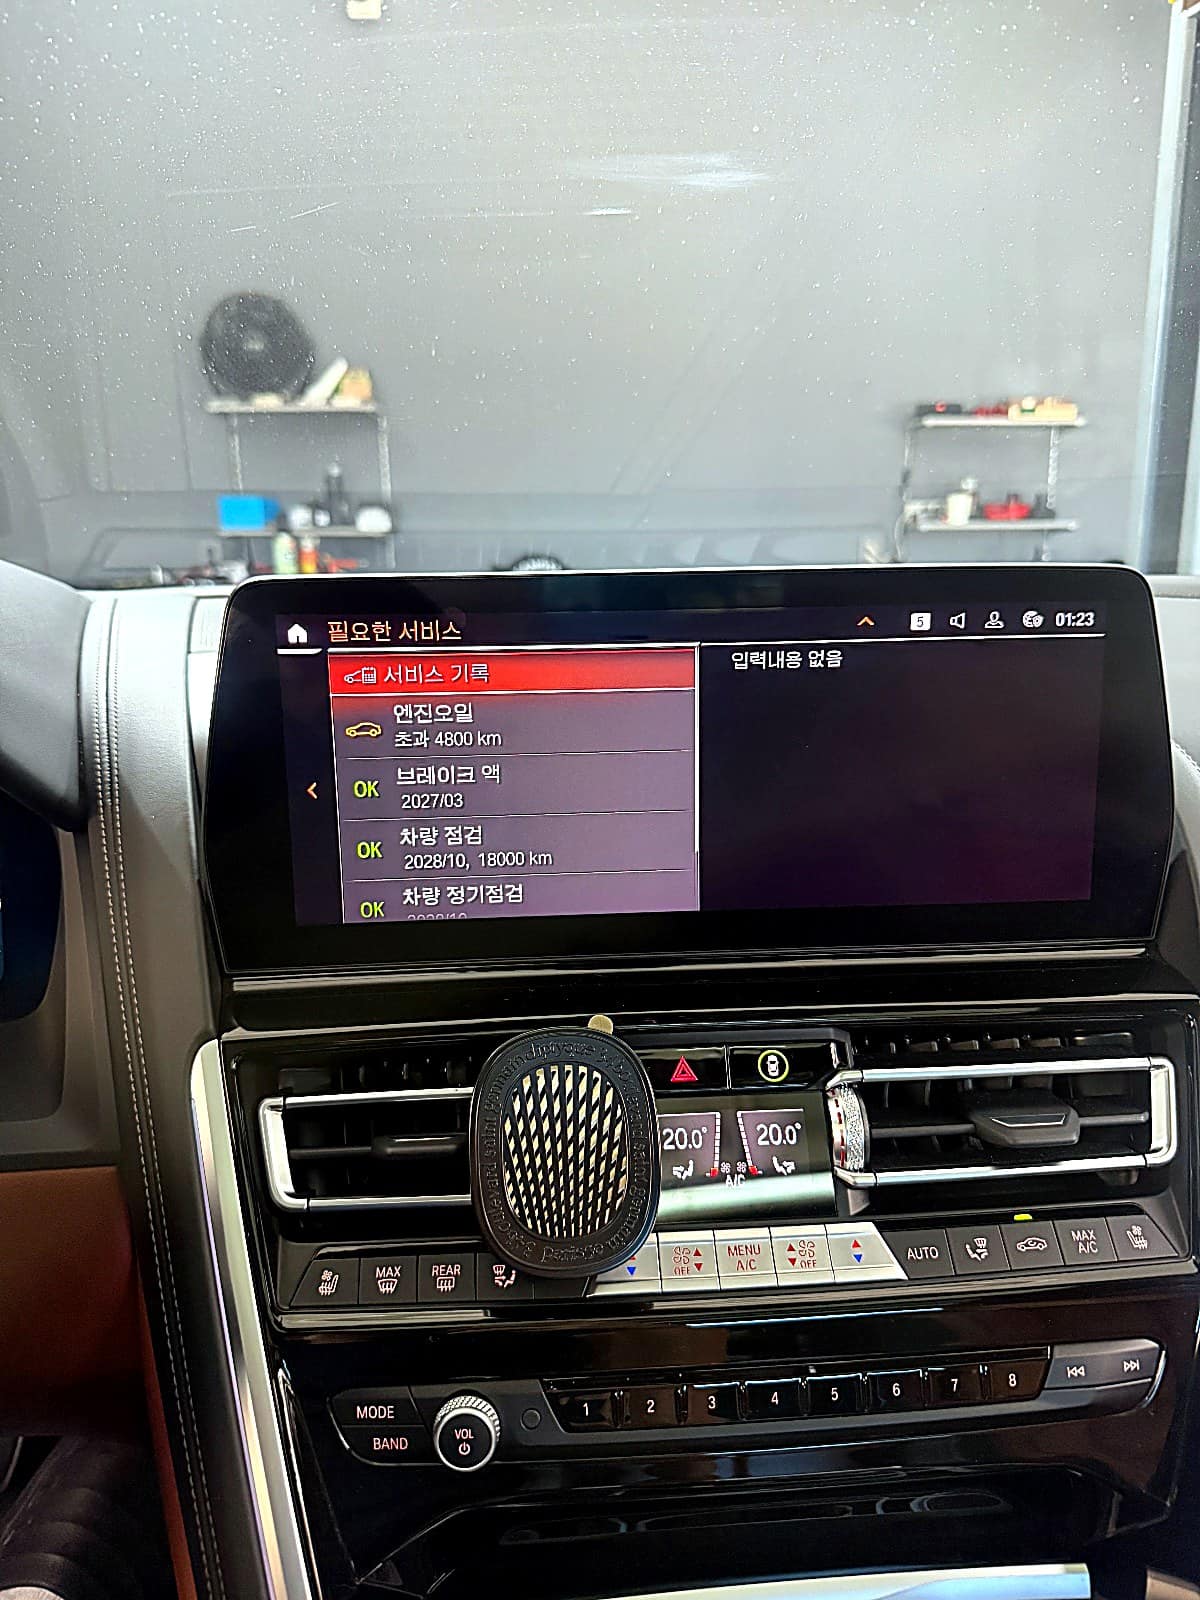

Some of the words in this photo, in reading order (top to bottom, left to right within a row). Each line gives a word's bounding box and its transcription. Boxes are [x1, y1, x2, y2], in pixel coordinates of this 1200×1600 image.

[915, 616, 925, 628] 5
[1055, 612, 1094, 627] 01:23
[327, 621, 391, 643] 필요한
[398, 619, 462, 642] 서비스
[731, 651, 803, 670] 입력내용
[808, 650, 843, 669] 없음
[383, 664, 444, 685] 서비스
[450, 663, 490, 684] 기록
[393, 702, 474, 724] 엔진오일
[394, 729, 430, 749] 초과
[434, 731, 474, 748] 4800
[477, 730, 502, 747] km
[396, 765, 477, 786] 브레이크
[481, 764, 501, 784] 액
[353, 780, 380, 798] OK
[401, 793, 464, 810] 2027/03
[400, 826, 438, 847] 차량
[444, 825, 483, 846] 점검
[356, 841, 383, 859] OK
[404, 852, 471, 871] 2028/10,
[478, 851, 526, 869] 18000
[529, 850, 553, 867] km
[402, 886, 441, 907] 차량
[446, 883, 523, 906] 정기점검
[359, 901, 385, 919] OK
[1072, 1229, 1096, 1243] MAX
[727, 1244, 761, 1257] MENU
[907, 1246, 939, 1261] AUTO
[1078, 1241, 1098, 1255] A/C
[375, 1265, 401, 1278] MAX
[431, 1264, 461, 1278] REAR
[736, 1258, 757, 1271] A/C
[800, 1259, 817, 1269] OFF
[582, 1402, 589, 1417] 1
[647, 1399, 655, 1414] 2
[707, 1394, 717, 1410] 3
[770, 1391, 779, 1406] 4
[830, 1386, 839, 1401] 5
[892, 1383, 901, 1397] 6
[950, 1378, 959, 1393] 7
[1008, 1373, 1017, 1388] 8
[356, 1405, 395, 1419] MODE
[454, 1428, 474, 1441] VOL
[373, 1437, 409, 1451] BAND
